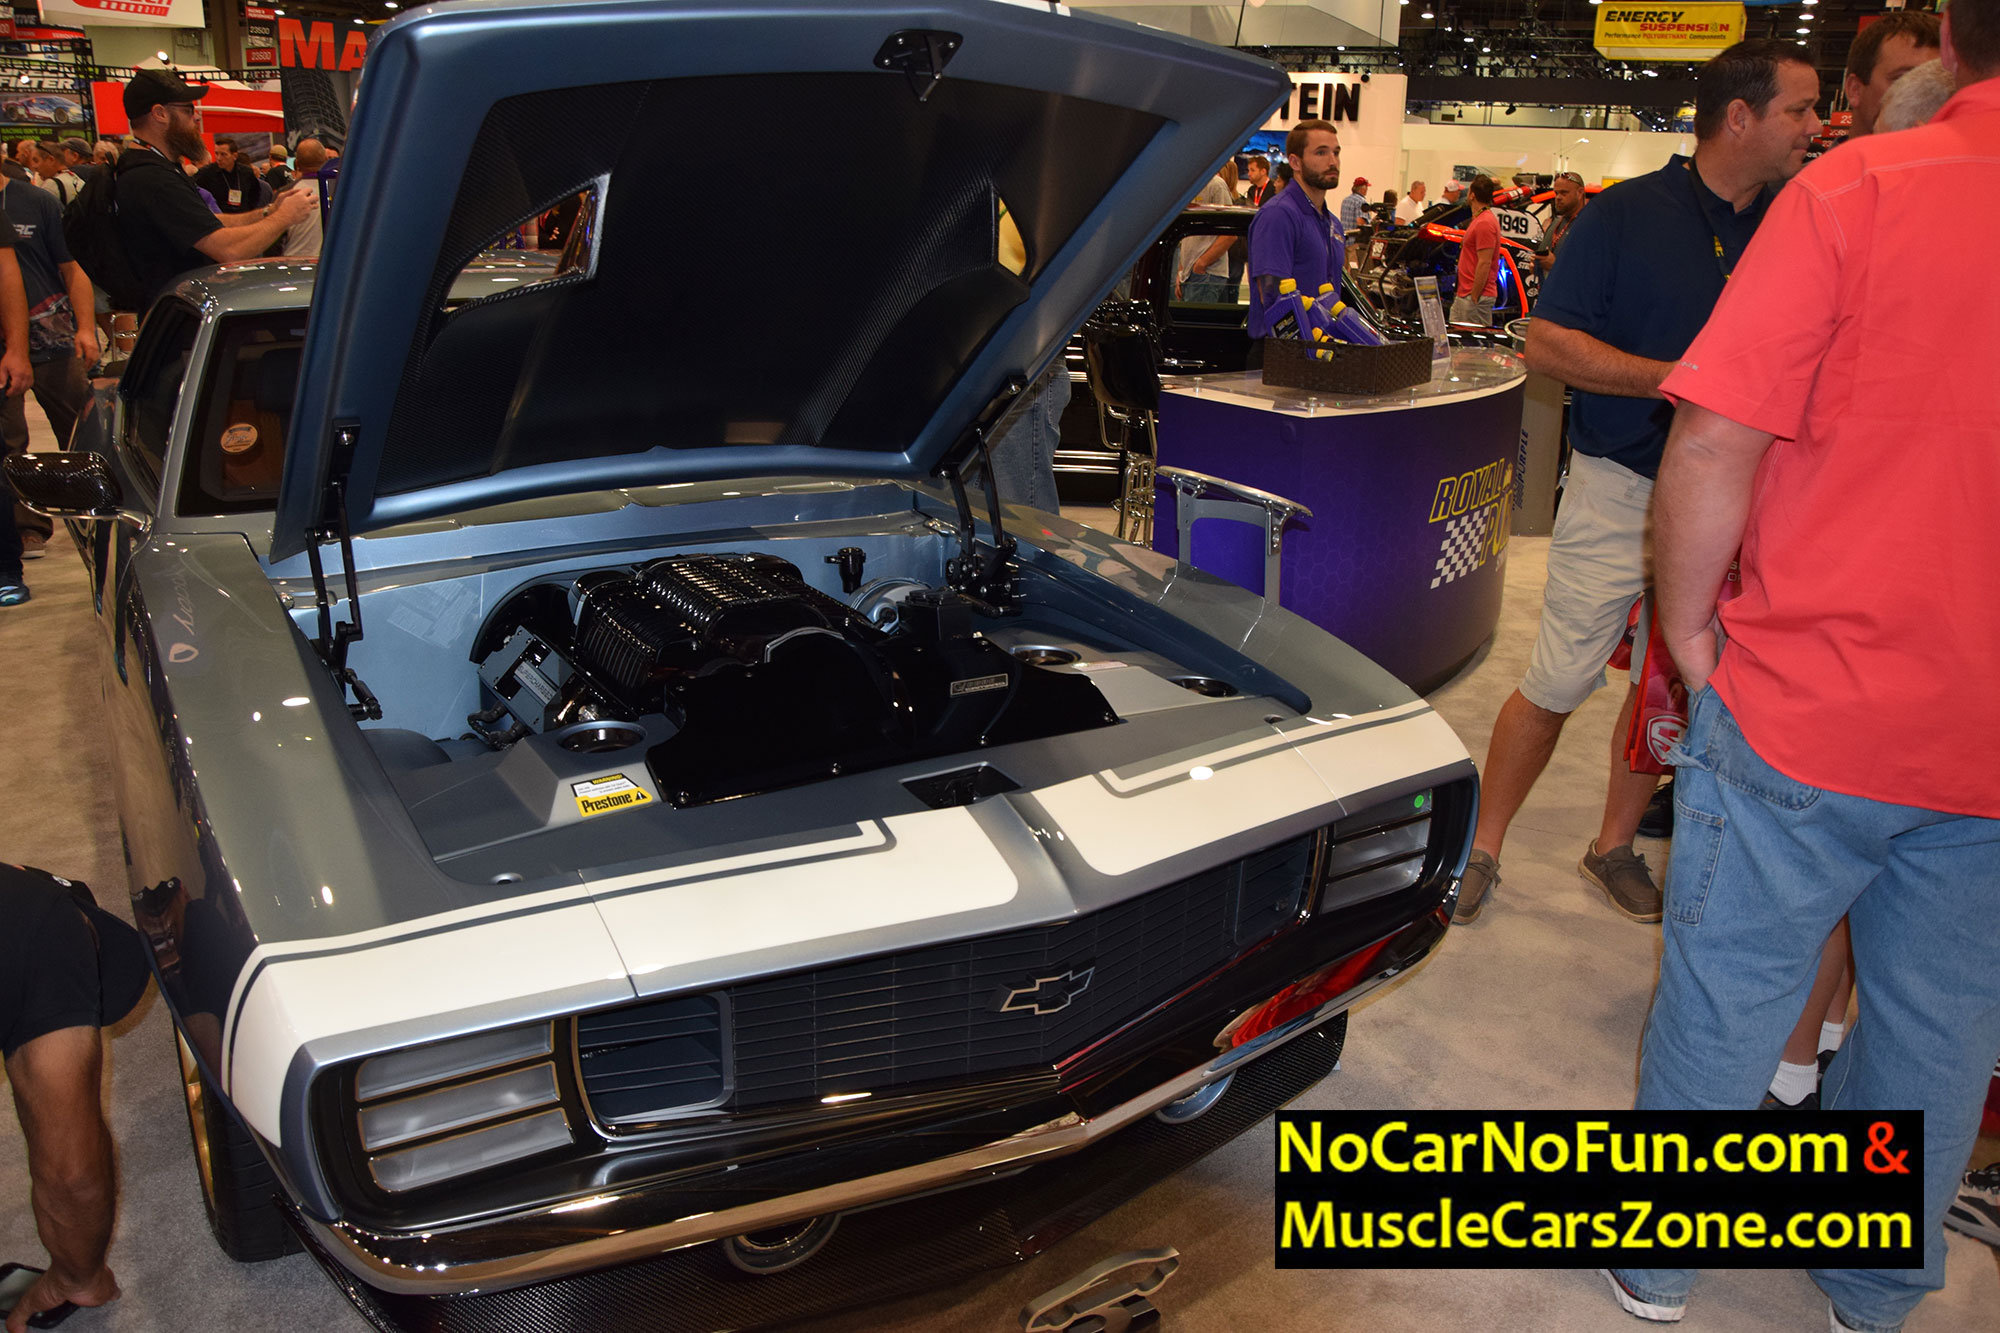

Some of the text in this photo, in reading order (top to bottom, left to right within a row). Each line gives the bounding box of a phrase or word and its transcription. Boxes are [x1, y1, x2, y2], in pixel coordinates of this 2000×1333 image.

[1604, 11, 1685, 23] ENERGY
[1642, 32, 1687, 40] POLYURETHANE
[1497, 213, 1529, 234] 1949
[1517, 428, 1529, 484] PURPLE
[1428, 457, 1505, 524] ROYAL
[581, 793, 633, 813] Prestone
